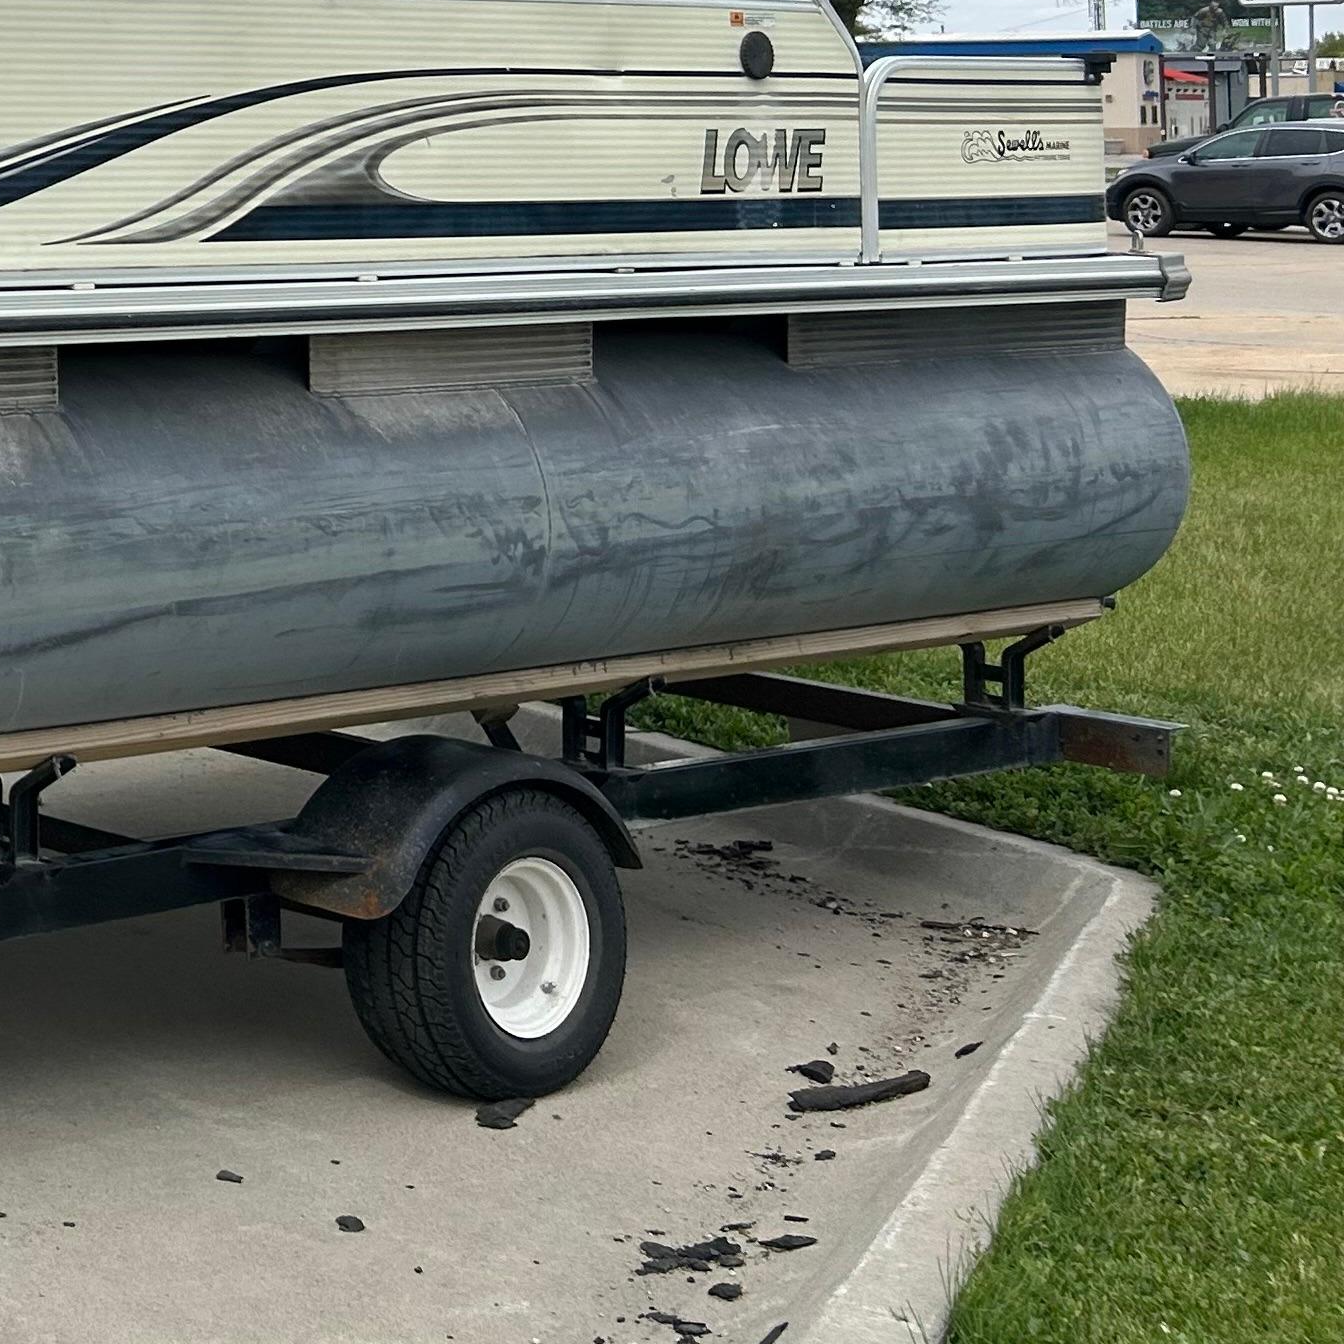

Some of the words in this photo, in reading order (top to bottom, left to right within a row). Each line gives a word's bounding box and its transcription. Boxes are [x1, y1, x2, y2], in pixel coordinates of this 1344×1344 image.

[700, 127, 826, 194] LOWE
[997, 130, 1045, 156] Sewell's
[1045, 140, 1071, 150] MARINE
